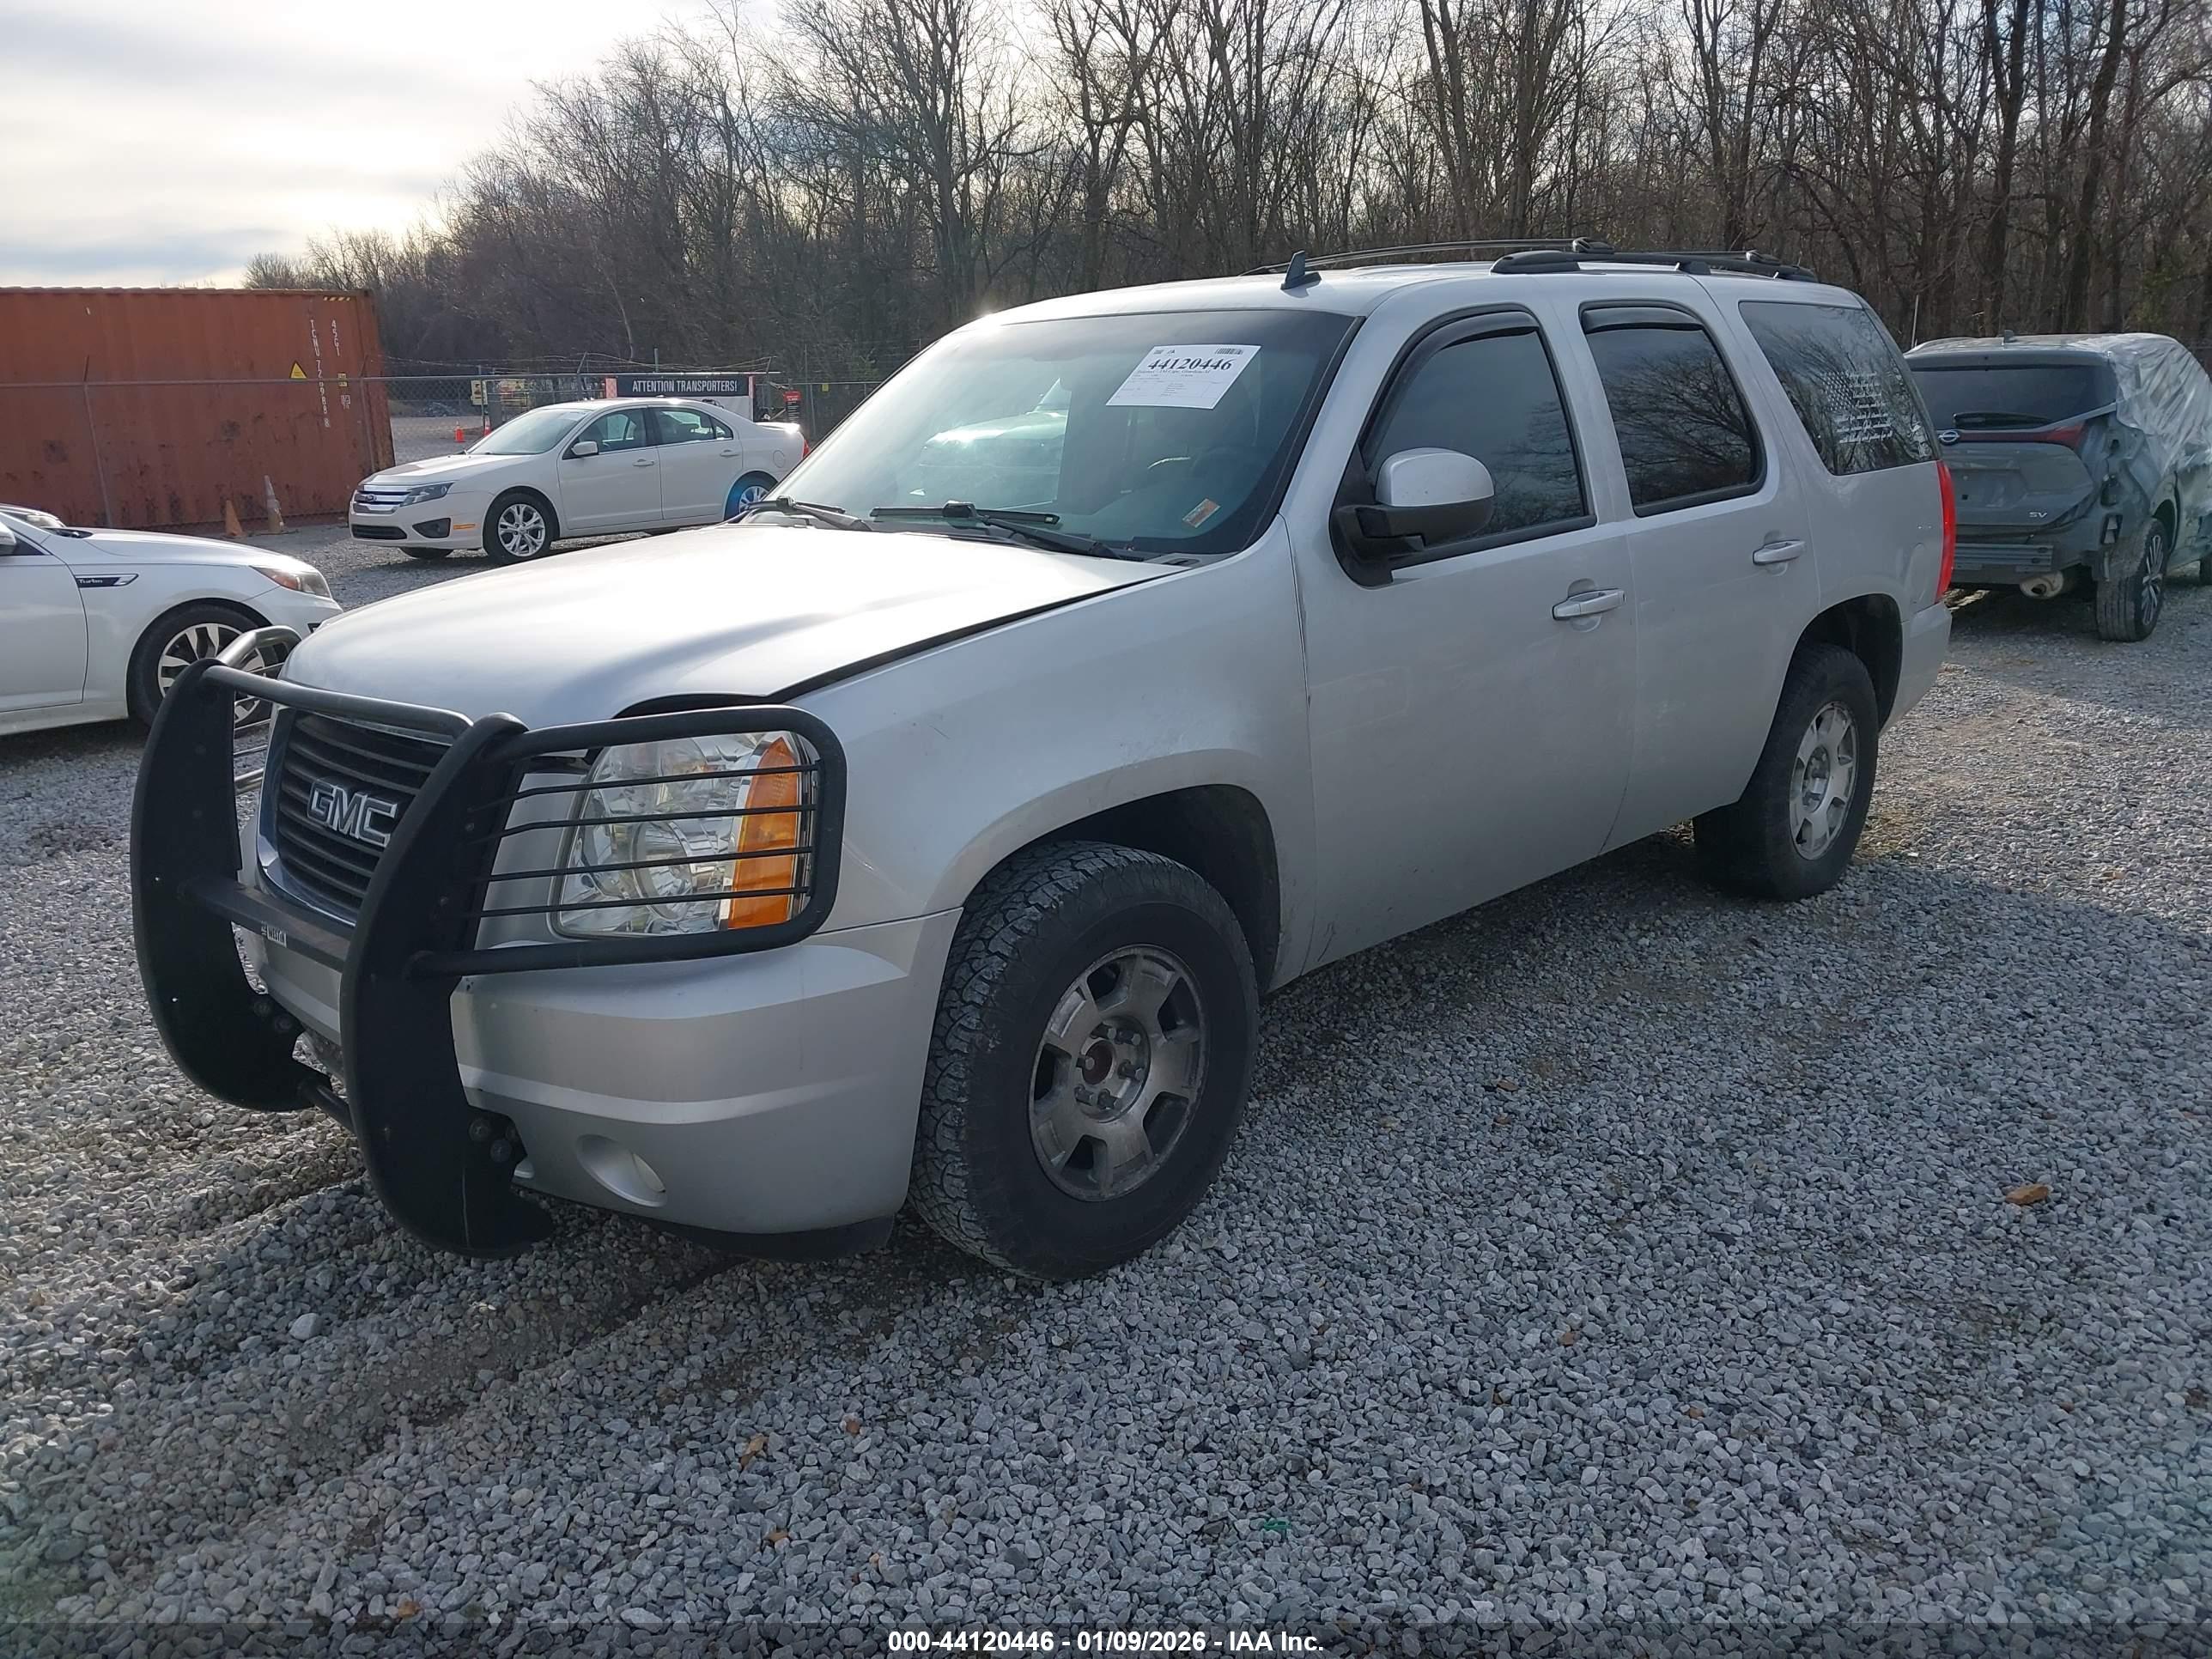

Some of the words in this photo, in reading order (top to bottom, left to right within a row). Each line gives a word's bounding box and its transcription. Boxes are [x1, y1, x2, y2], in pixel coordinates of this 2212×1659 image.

[1147, 357, 1235, 371] 44120446
[632, 379, 675, 392] ATTENTION
[676, 379, 738, 392] TRANSPORTERS!
[307, 779, 398, 848] GMC
